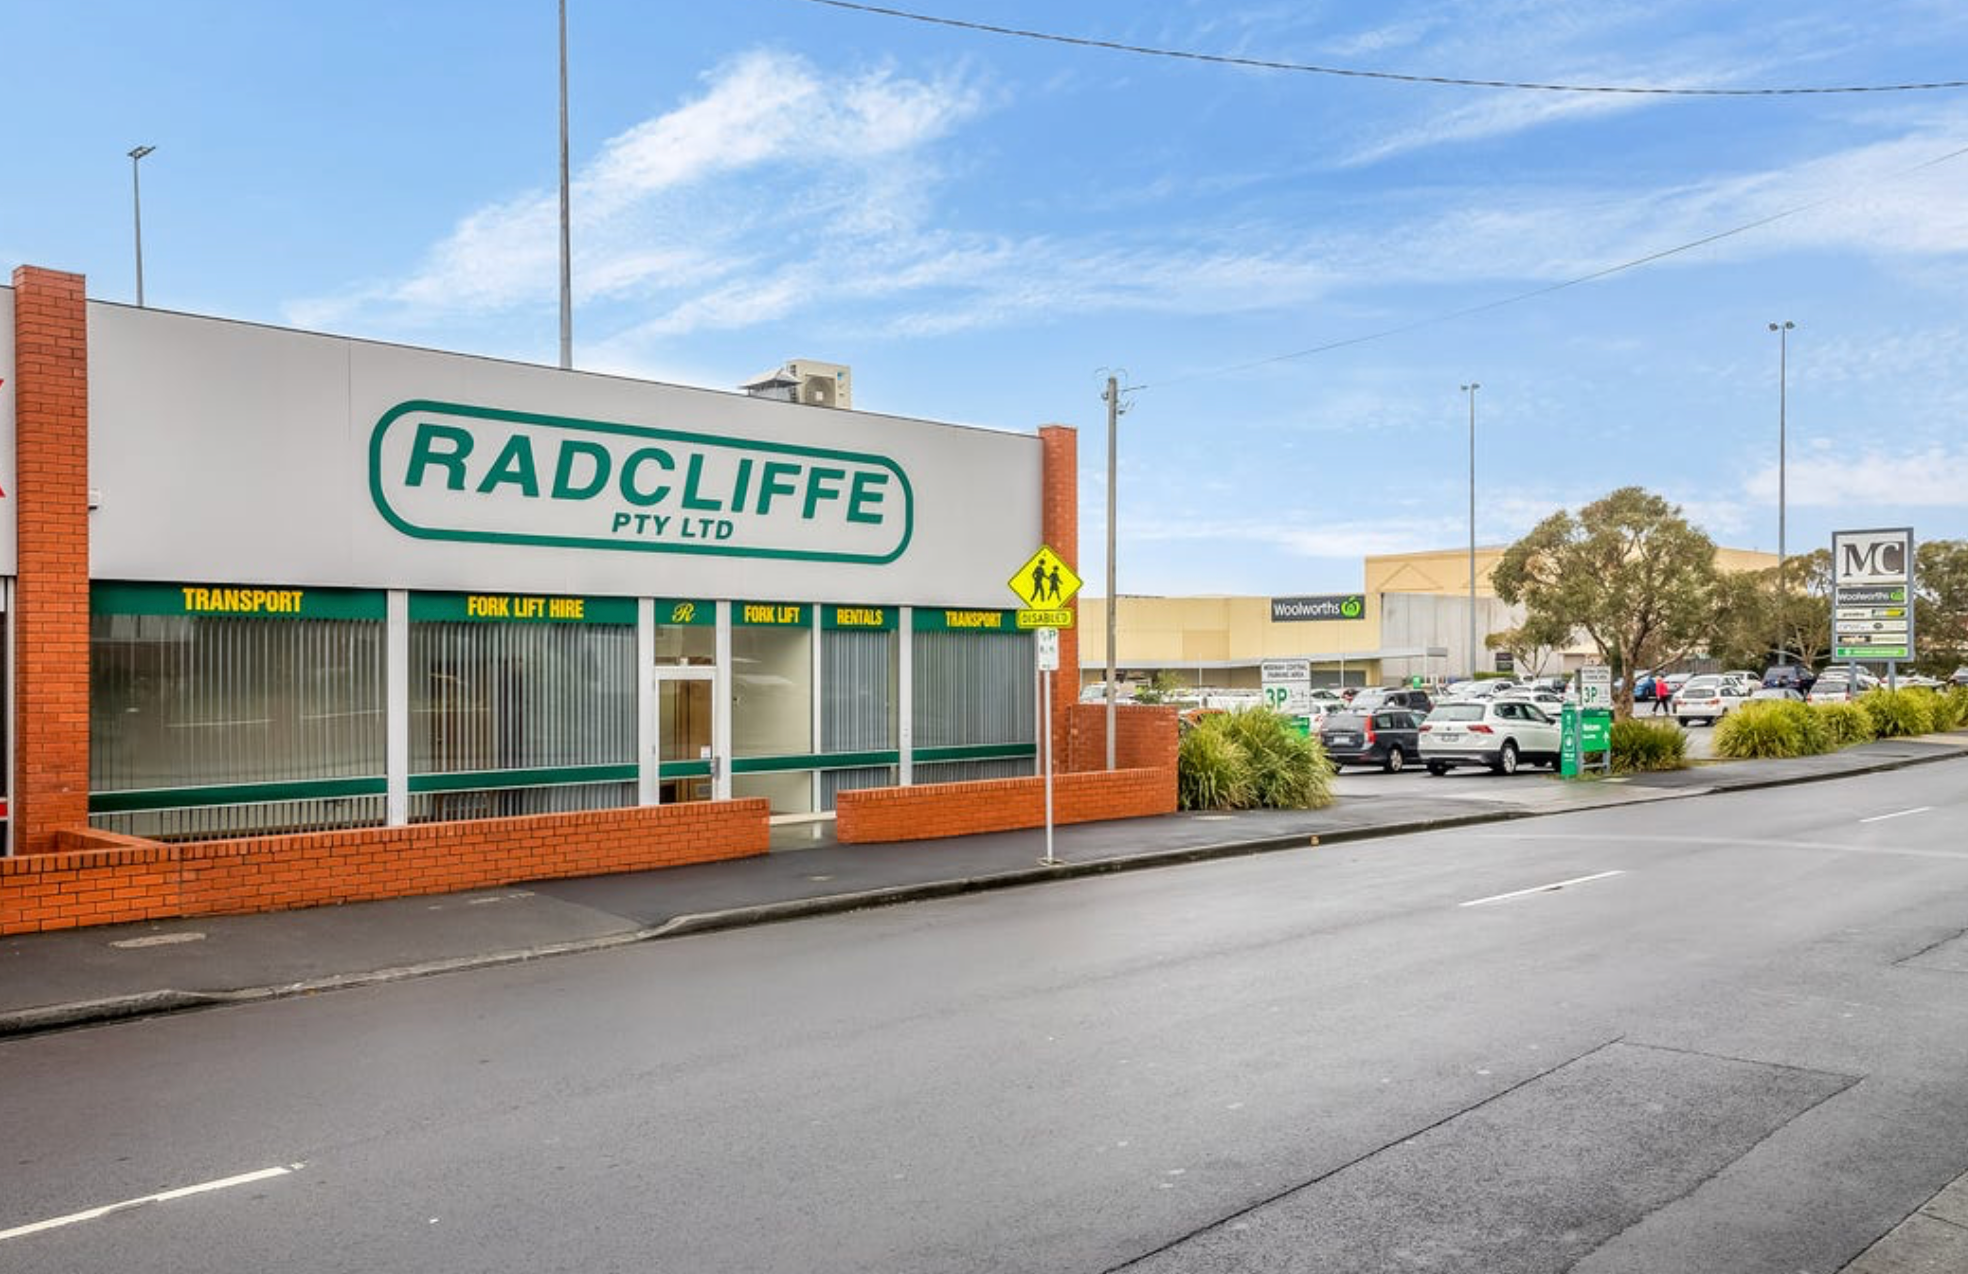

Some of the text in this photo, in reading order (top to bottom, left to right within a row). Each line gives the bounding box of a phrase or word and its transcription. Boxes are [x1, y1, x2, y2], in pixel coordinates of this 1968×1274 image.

[405, 423, 890, 524] RADCLIFFE
[611, 513, 734, 540] PTY LTD
[1842, 541, 1905, 577] MC
[182, 588, 303, 612] TRANSPORT
[468, 596, 584, 619] FORK LIFT HIRE
[1273, 601, 1340, 617] Woolworths
[744, 605, 800, 624] FORK LIFT
[836, 608, 883, 625] RENTALS
[945, 611, 1001, 627] TRANSPORT
[1022, 612, 1069, 624] DISABLED
[1265, 688, 1287, 709] 3P
[1583, 686, 1598, 703] 3P
